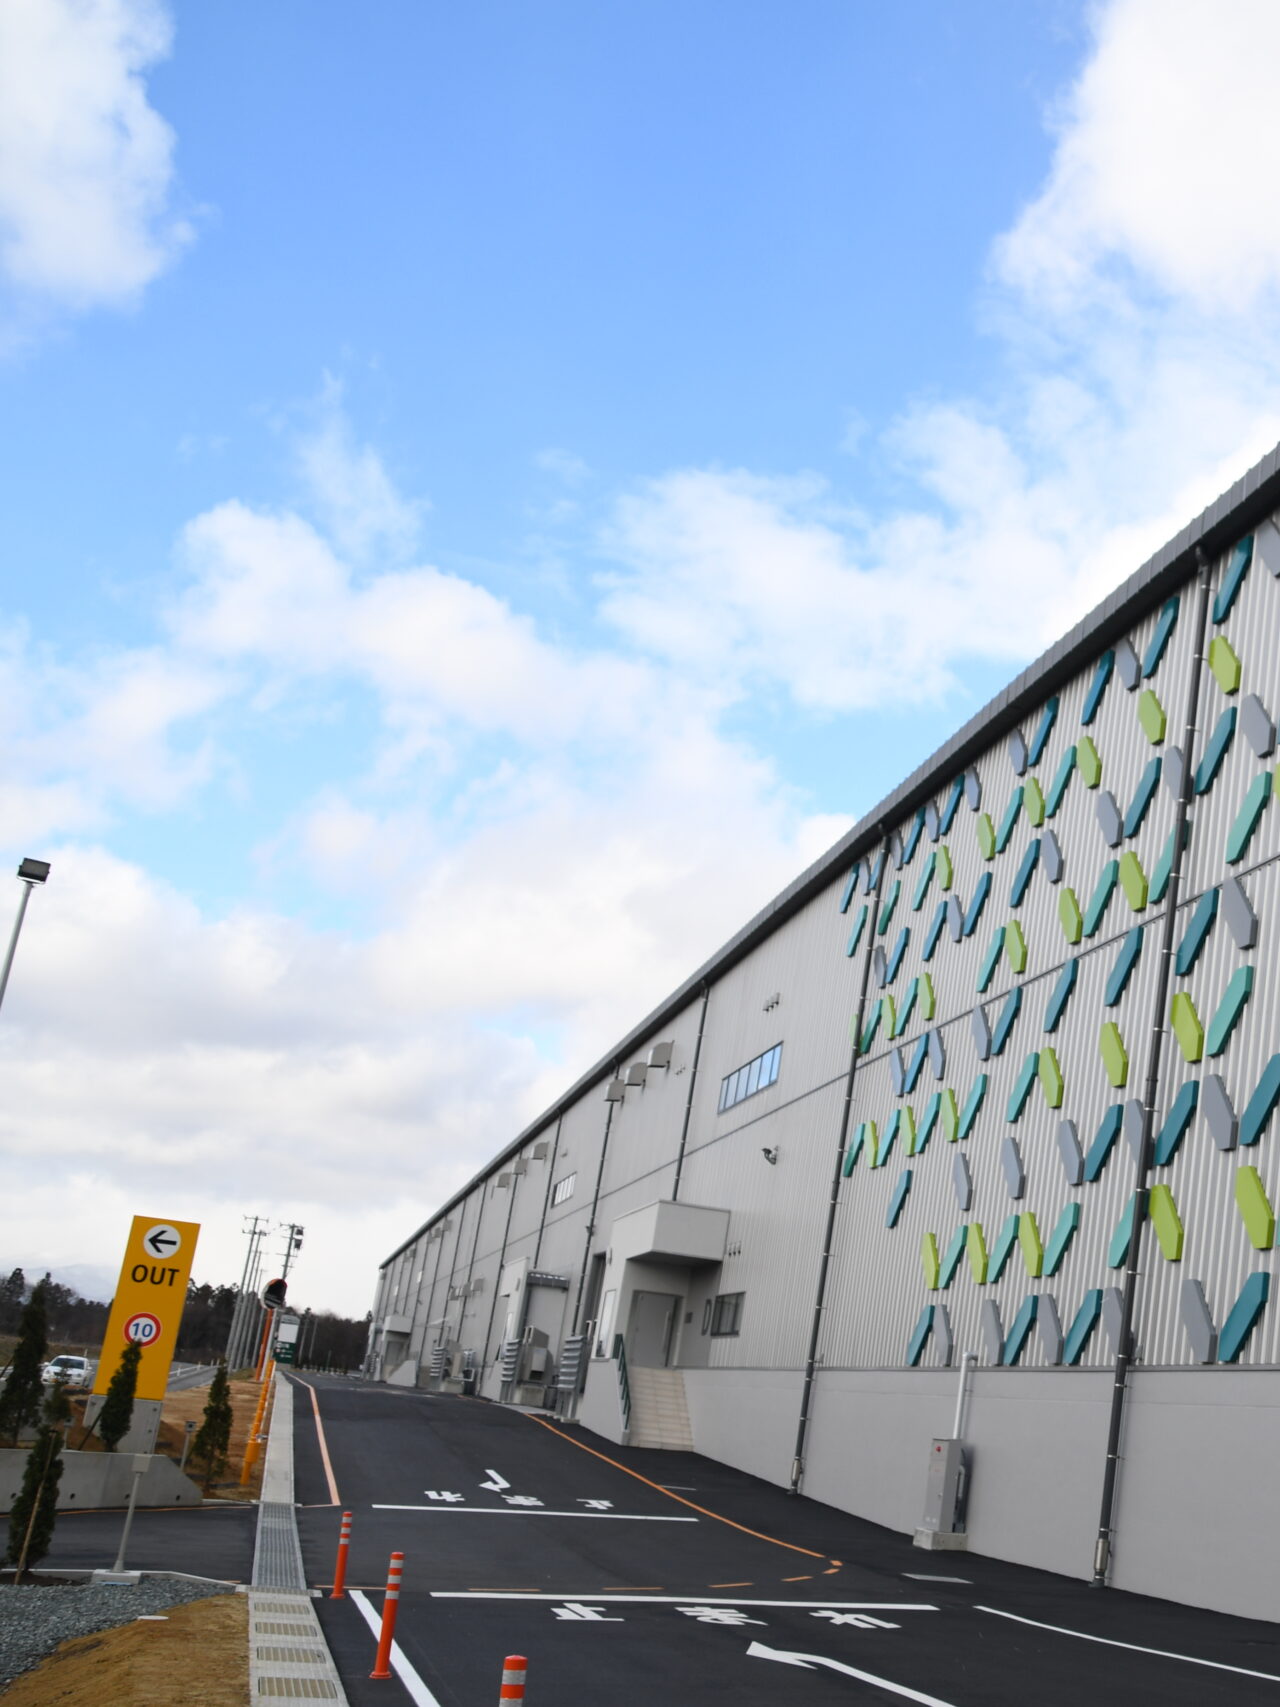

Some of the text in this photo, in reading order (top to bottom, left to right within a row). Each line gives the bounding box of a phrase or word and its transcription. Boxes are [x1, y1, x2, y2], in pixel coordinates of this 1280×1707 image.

[131, 1264, 179, 1287] OUT
[132, 1322, 153, 1338] 10
[550, 1602, 901, 1629] 止まれ
